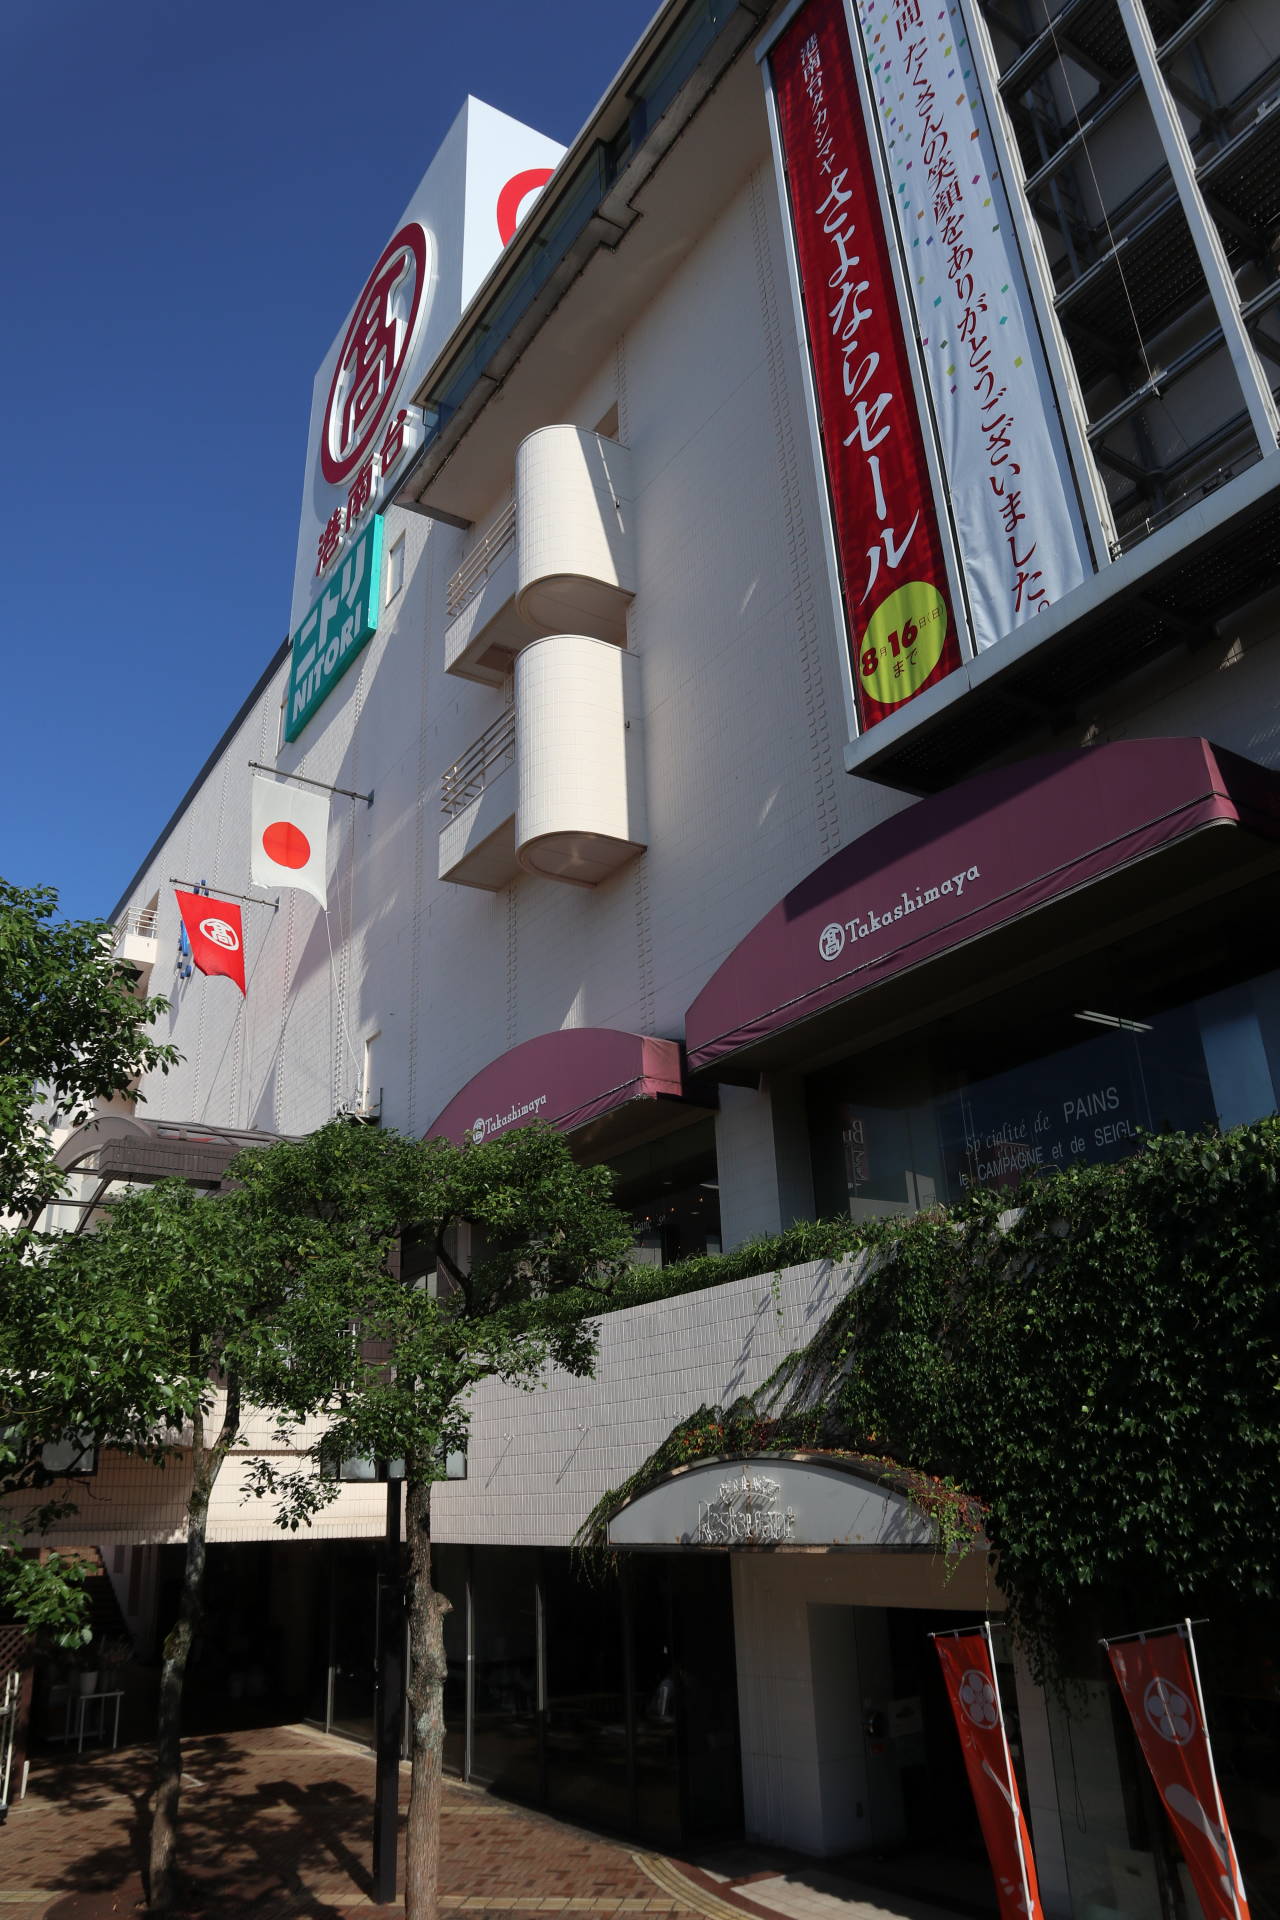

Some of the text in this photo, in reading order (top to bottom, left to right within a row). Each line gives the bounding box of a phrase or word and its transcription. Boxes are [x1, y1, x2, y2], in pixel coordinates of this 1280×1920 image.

[816, 168, 920, 606] さよならセール
[316, 409, 409, 577] 港南台
[296, 536, 367, 683] ニトリ
[291, 600, 363, 723] NITORI
[892, 648, 920, 678] まで
[845, 865, 981, 943] Takashimaya
[485, 1094, 547, 1135] Takashimaya
[1033, 1109, 1051, 1134] de
[1063, 1086, 1121, 1124] PAINS
[977, 1146, 1044, 1181] CAMPAGNE
[1051, 1140, 1064, 1160] et
[1070, 1135, 1086, 1154] de
